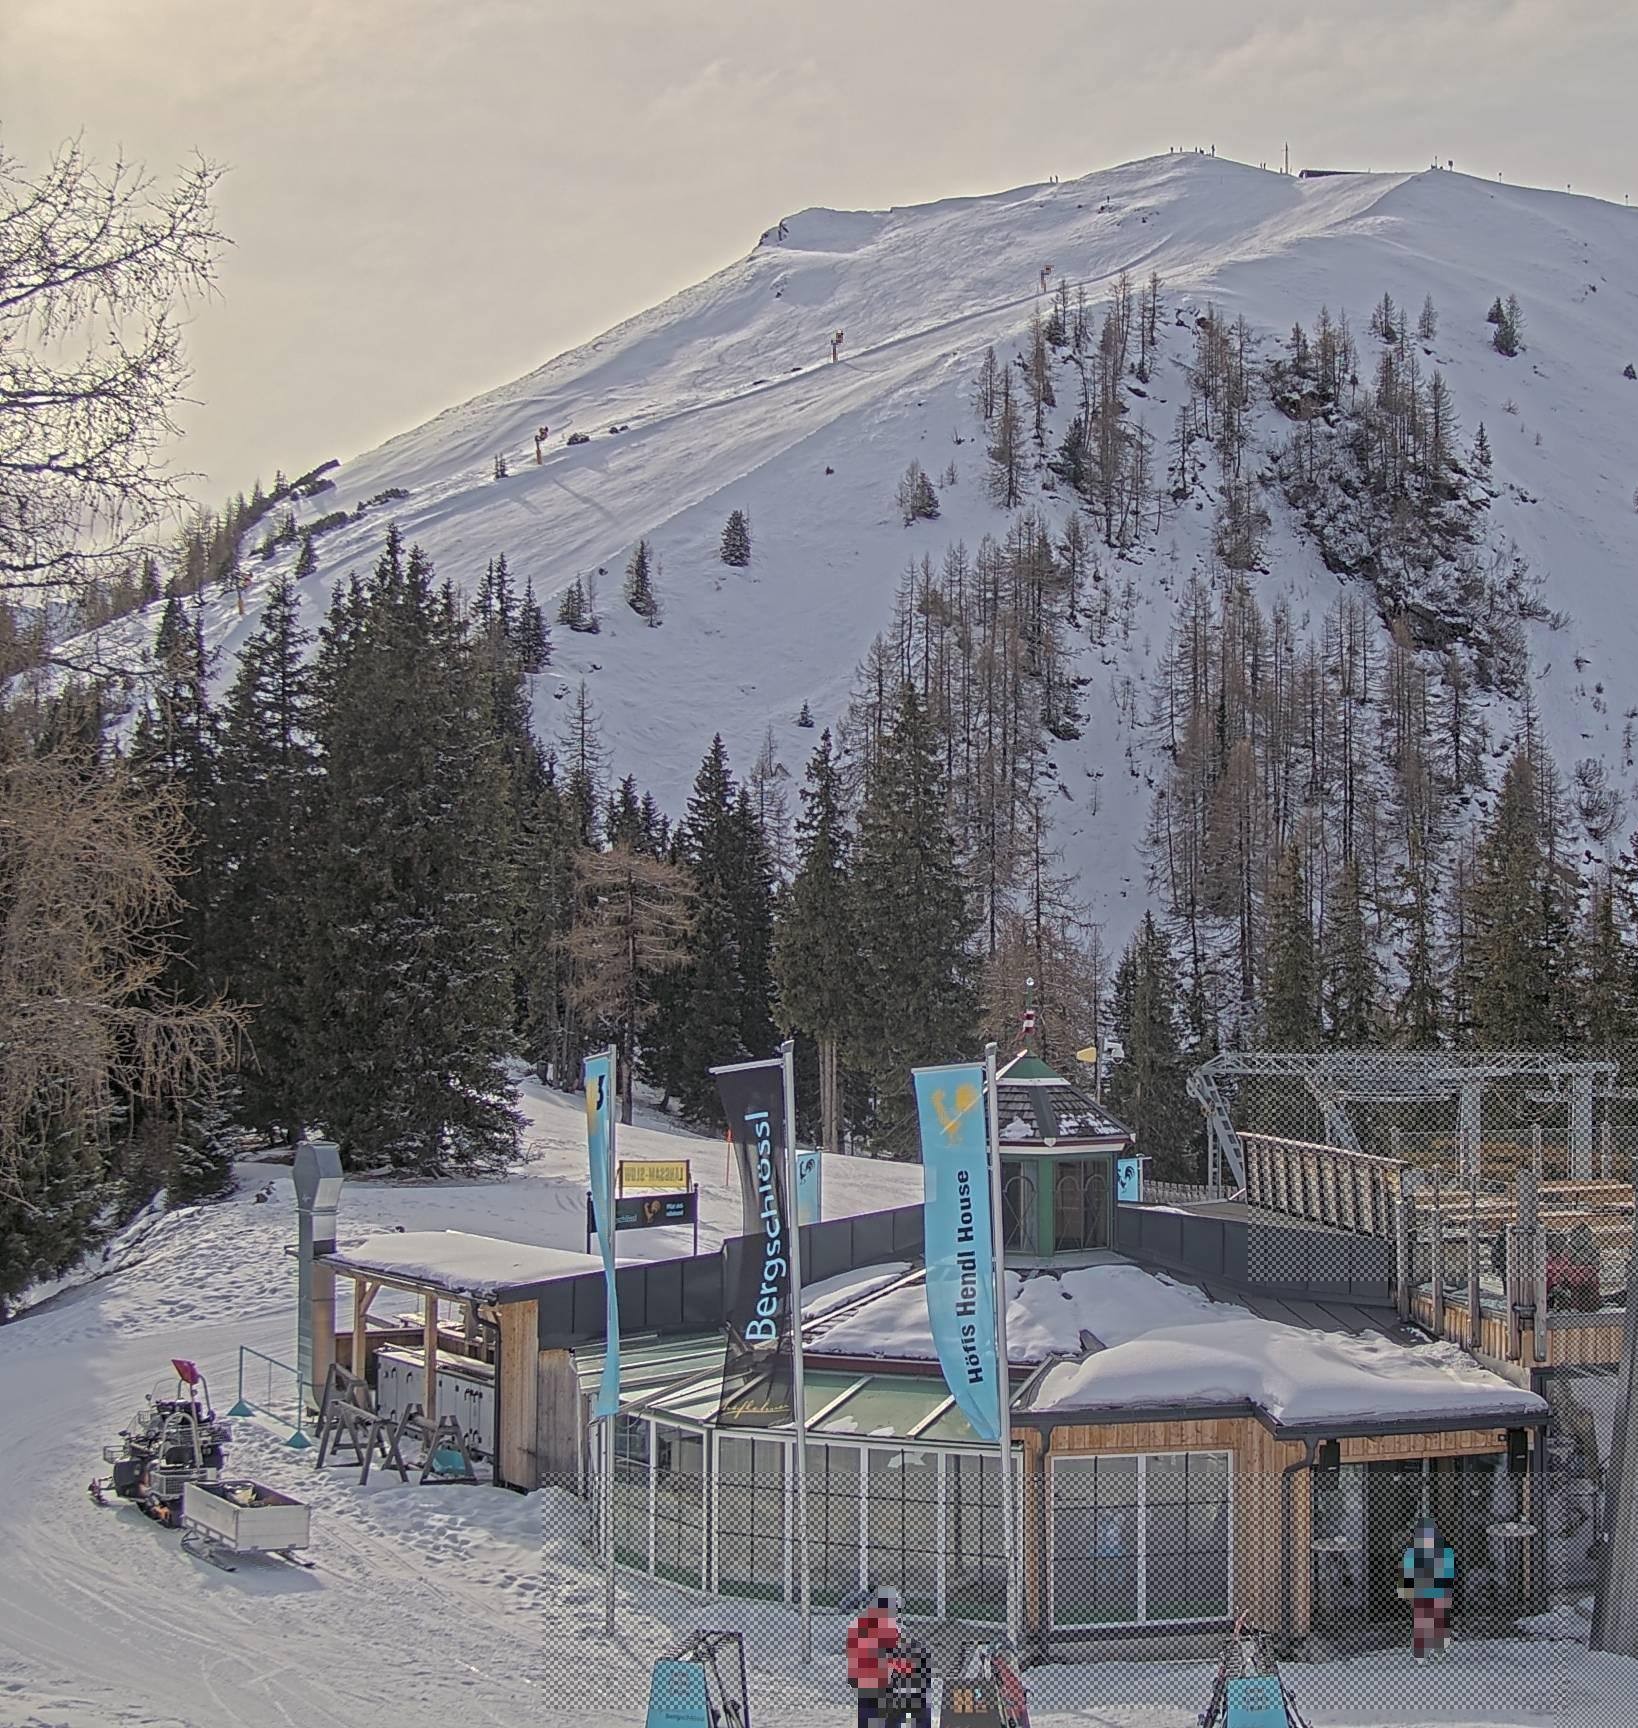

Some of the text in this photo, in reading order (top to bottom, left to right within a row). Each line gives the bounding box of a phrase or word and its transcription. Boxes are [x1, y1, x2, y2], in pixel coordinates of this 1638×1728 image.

[744, 1110, 787, 1340] Bergschlössl
[956, 1169, 984, 1385] Höfis Hendl House
